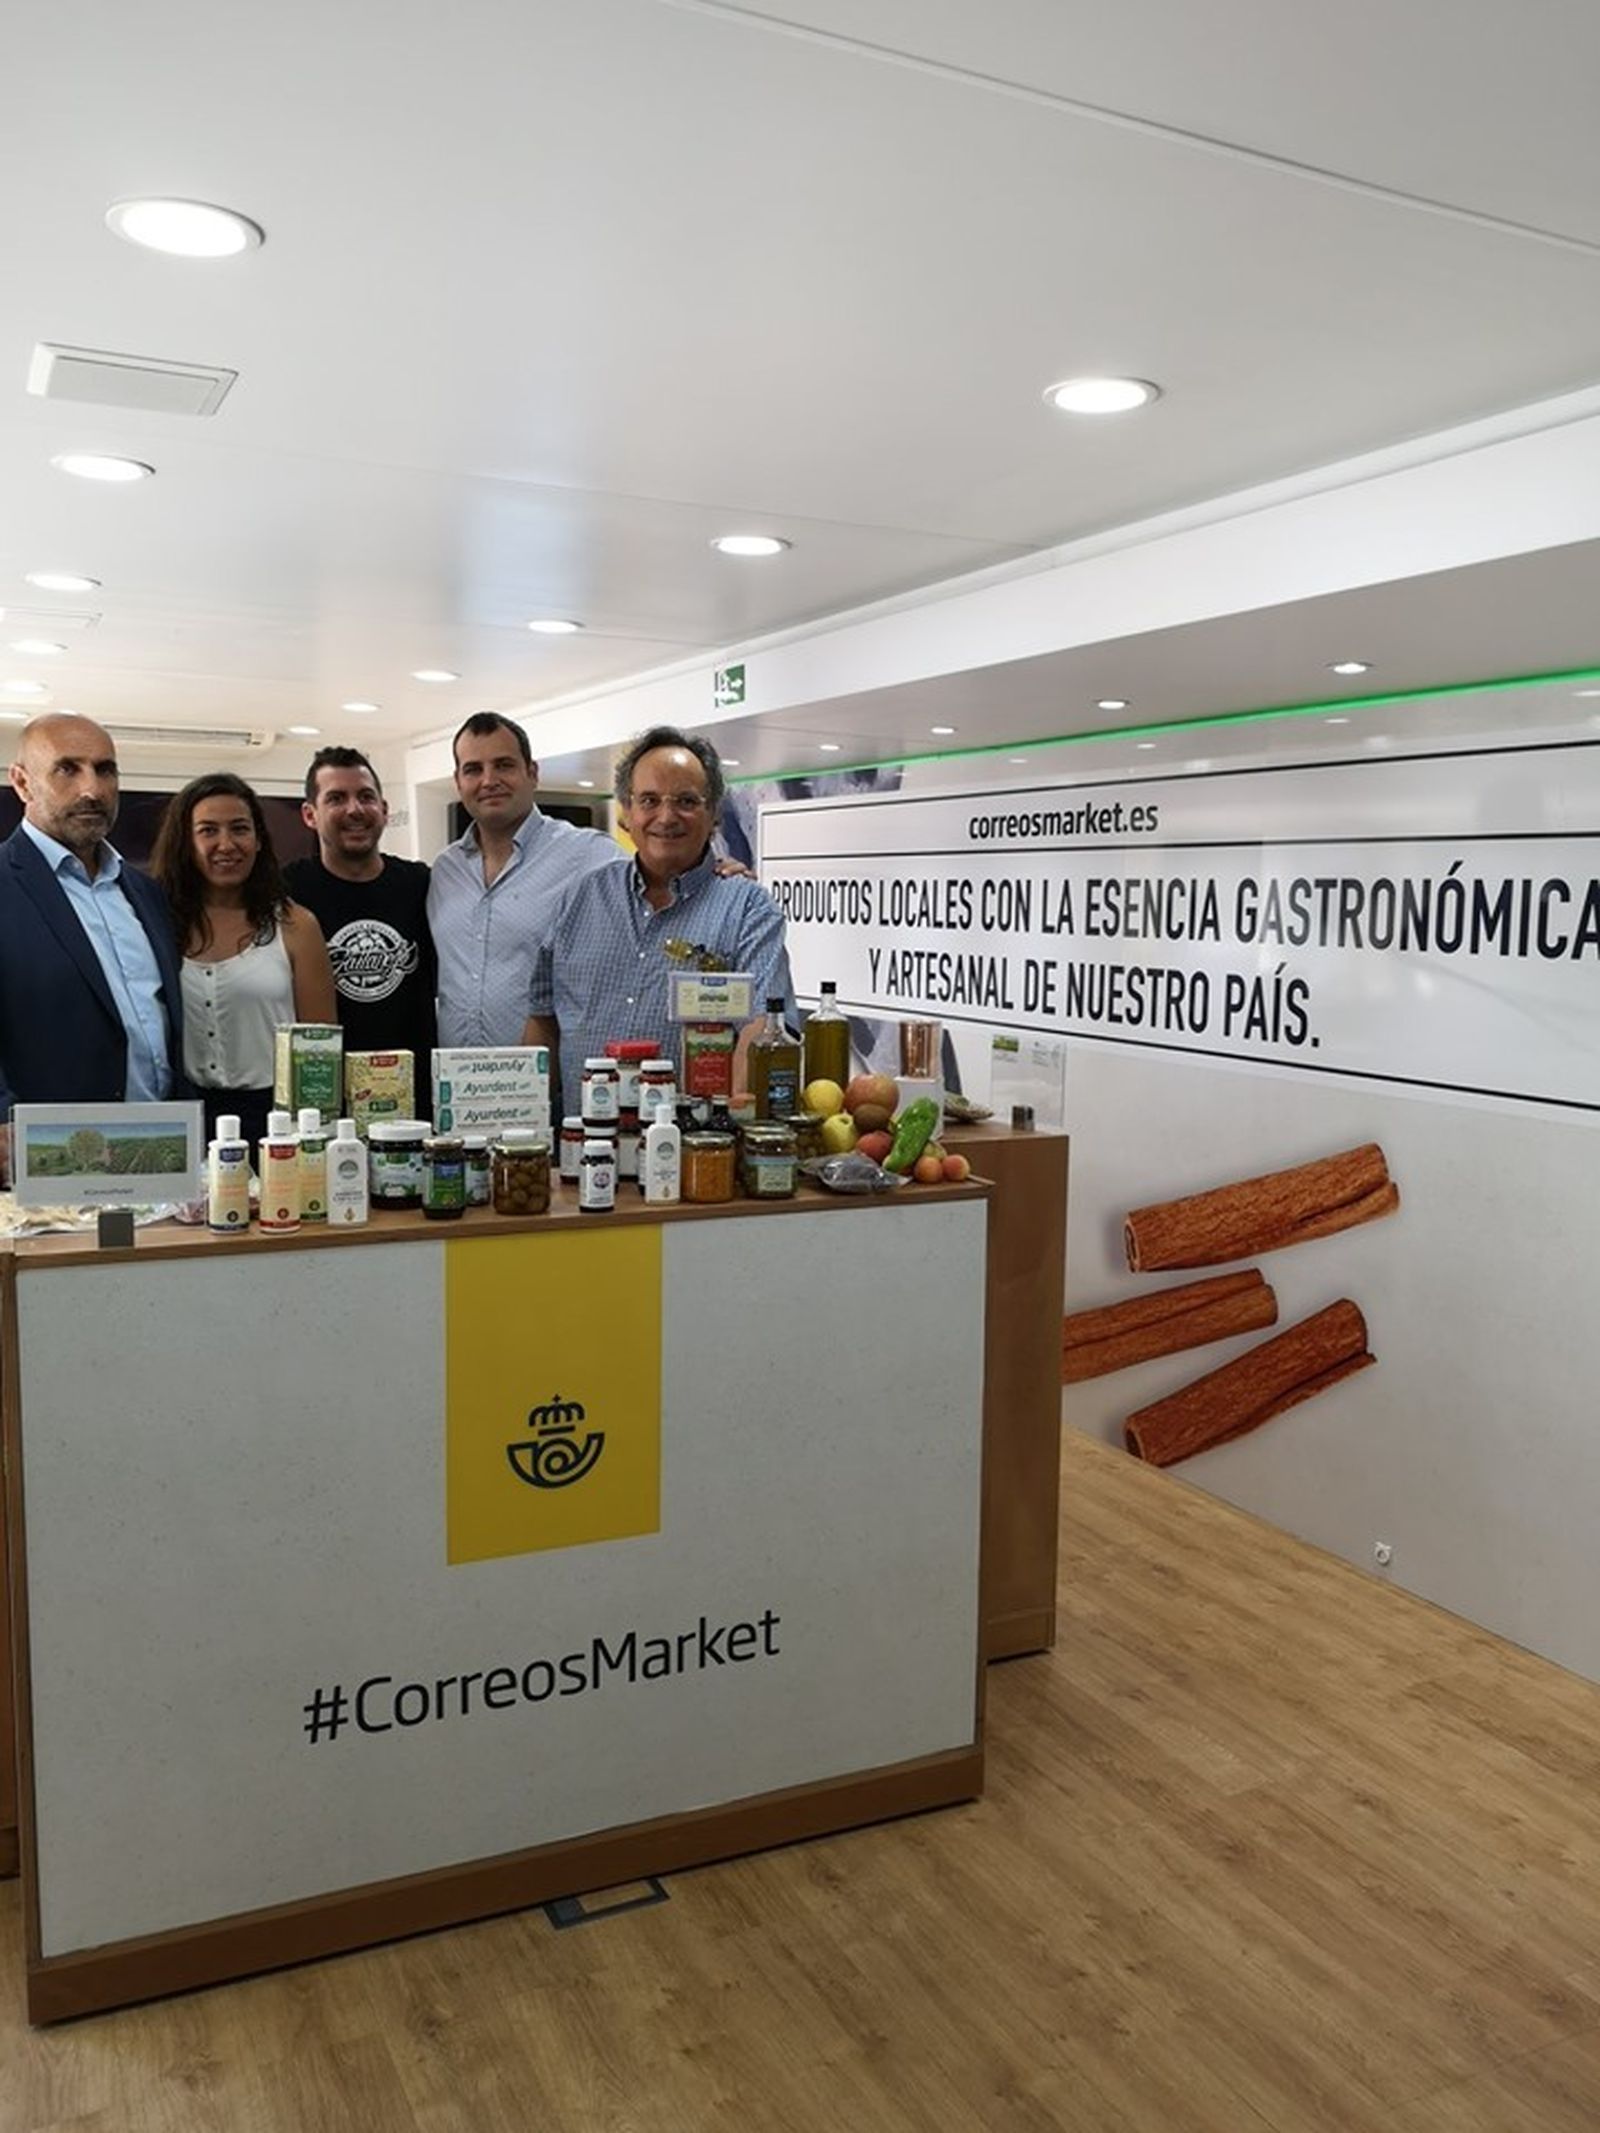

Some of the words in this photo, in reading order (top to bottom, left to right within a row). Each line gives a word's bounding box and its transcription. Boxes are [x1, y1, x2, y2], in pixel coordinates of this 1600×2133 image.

[969, 801, 1159, 840] correosmarket.es
[879, 879, 972, 930] LOCALES
[981, 879, 1031, 933] CON
[1041, 879, 1074, 935] LA
[1085, 878, 1221, 941] ESENCIA
[1235, 860, 1600, 960] GASTRONÓMICA
[868, 947, 882, 994] Y
[886, 948, 1014, 1010] ARTESANAL
[1024, 960, 1057, 1015] DE
[1066, 962, 1210, 1034] NUESTRO
[1223, 962, 1320, 1048] PAÍS.
[463, 1080, 518, 1095] Ayurdent
[463, 1107, 519, 1122] Ayurdent
[303, 1609, 781, 1744] #CorreosMarket
